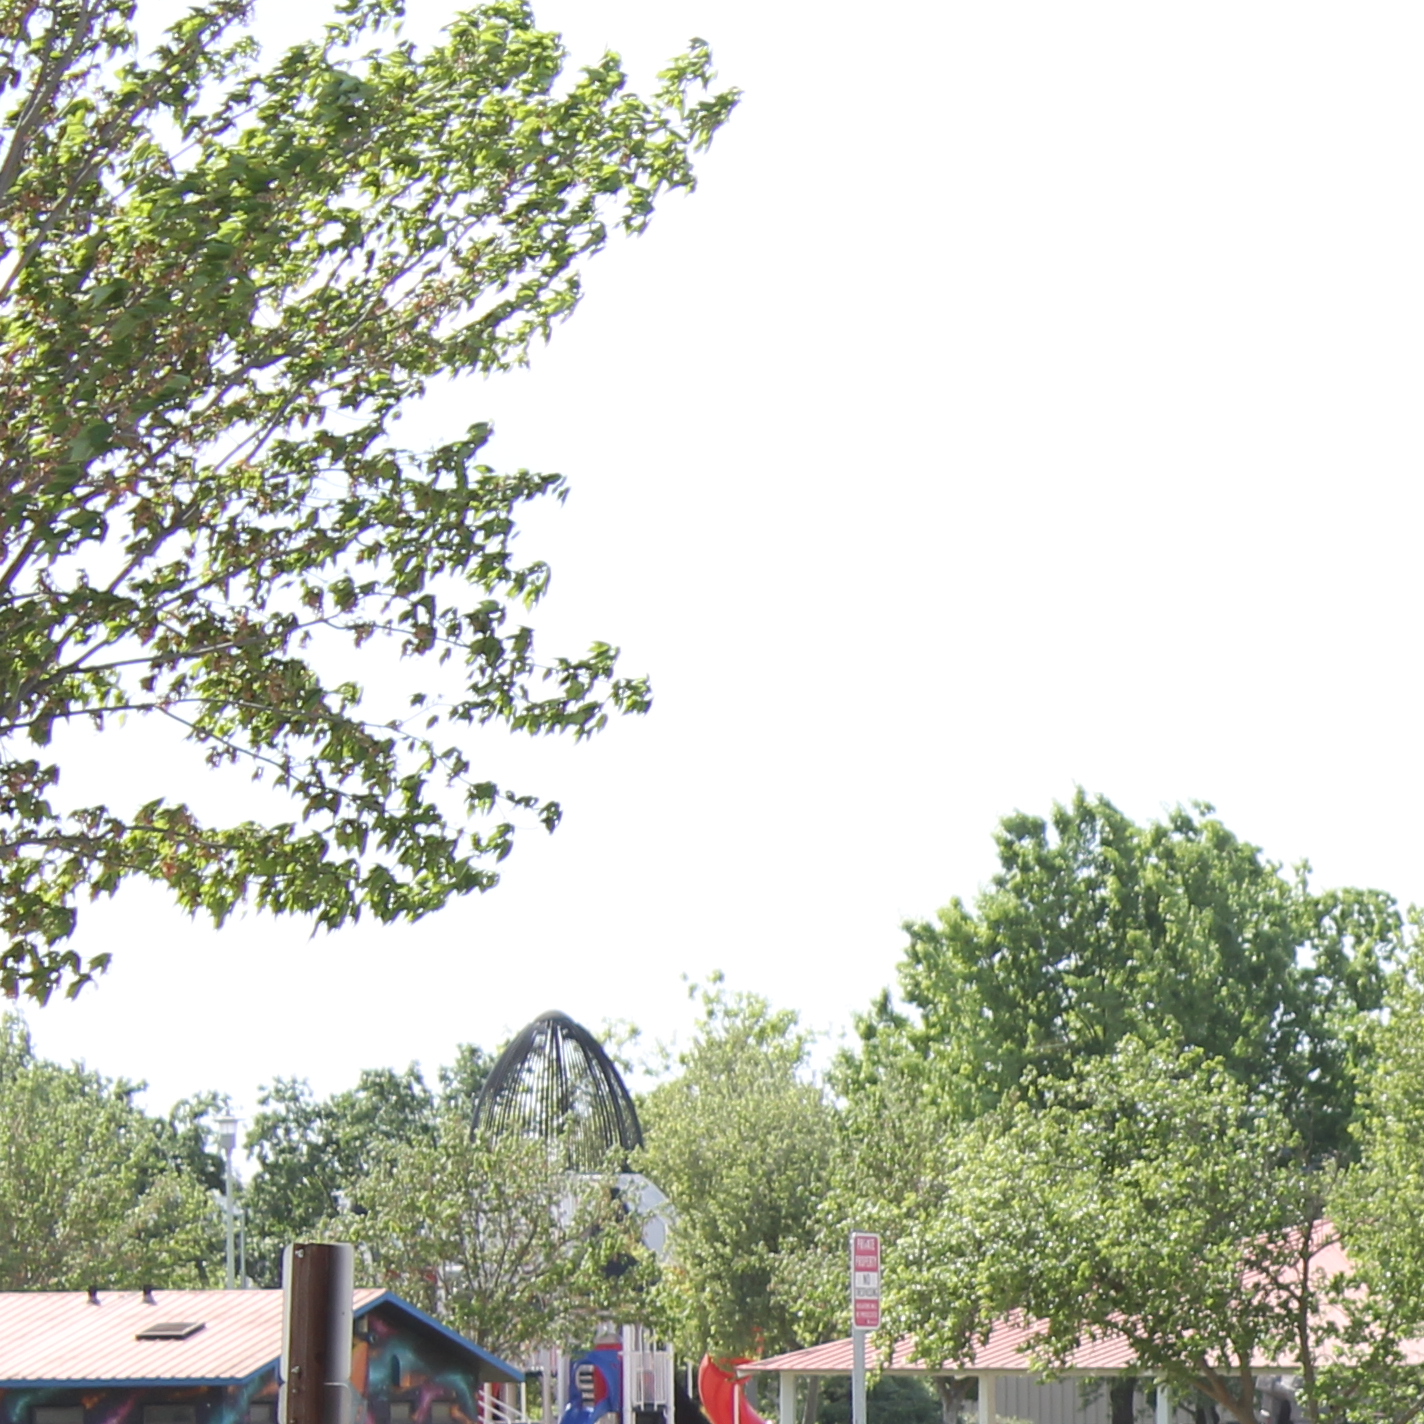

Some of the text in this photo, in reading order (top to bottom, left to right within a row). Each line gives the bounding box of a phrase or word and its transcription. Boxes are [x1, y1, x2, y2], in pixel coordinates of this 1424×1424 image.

[857, 1238, 875, 1251] PRIVATE
[855, 1255, 877, 1268] PROPERTY
[863, 1273, 871, 1285] NO
